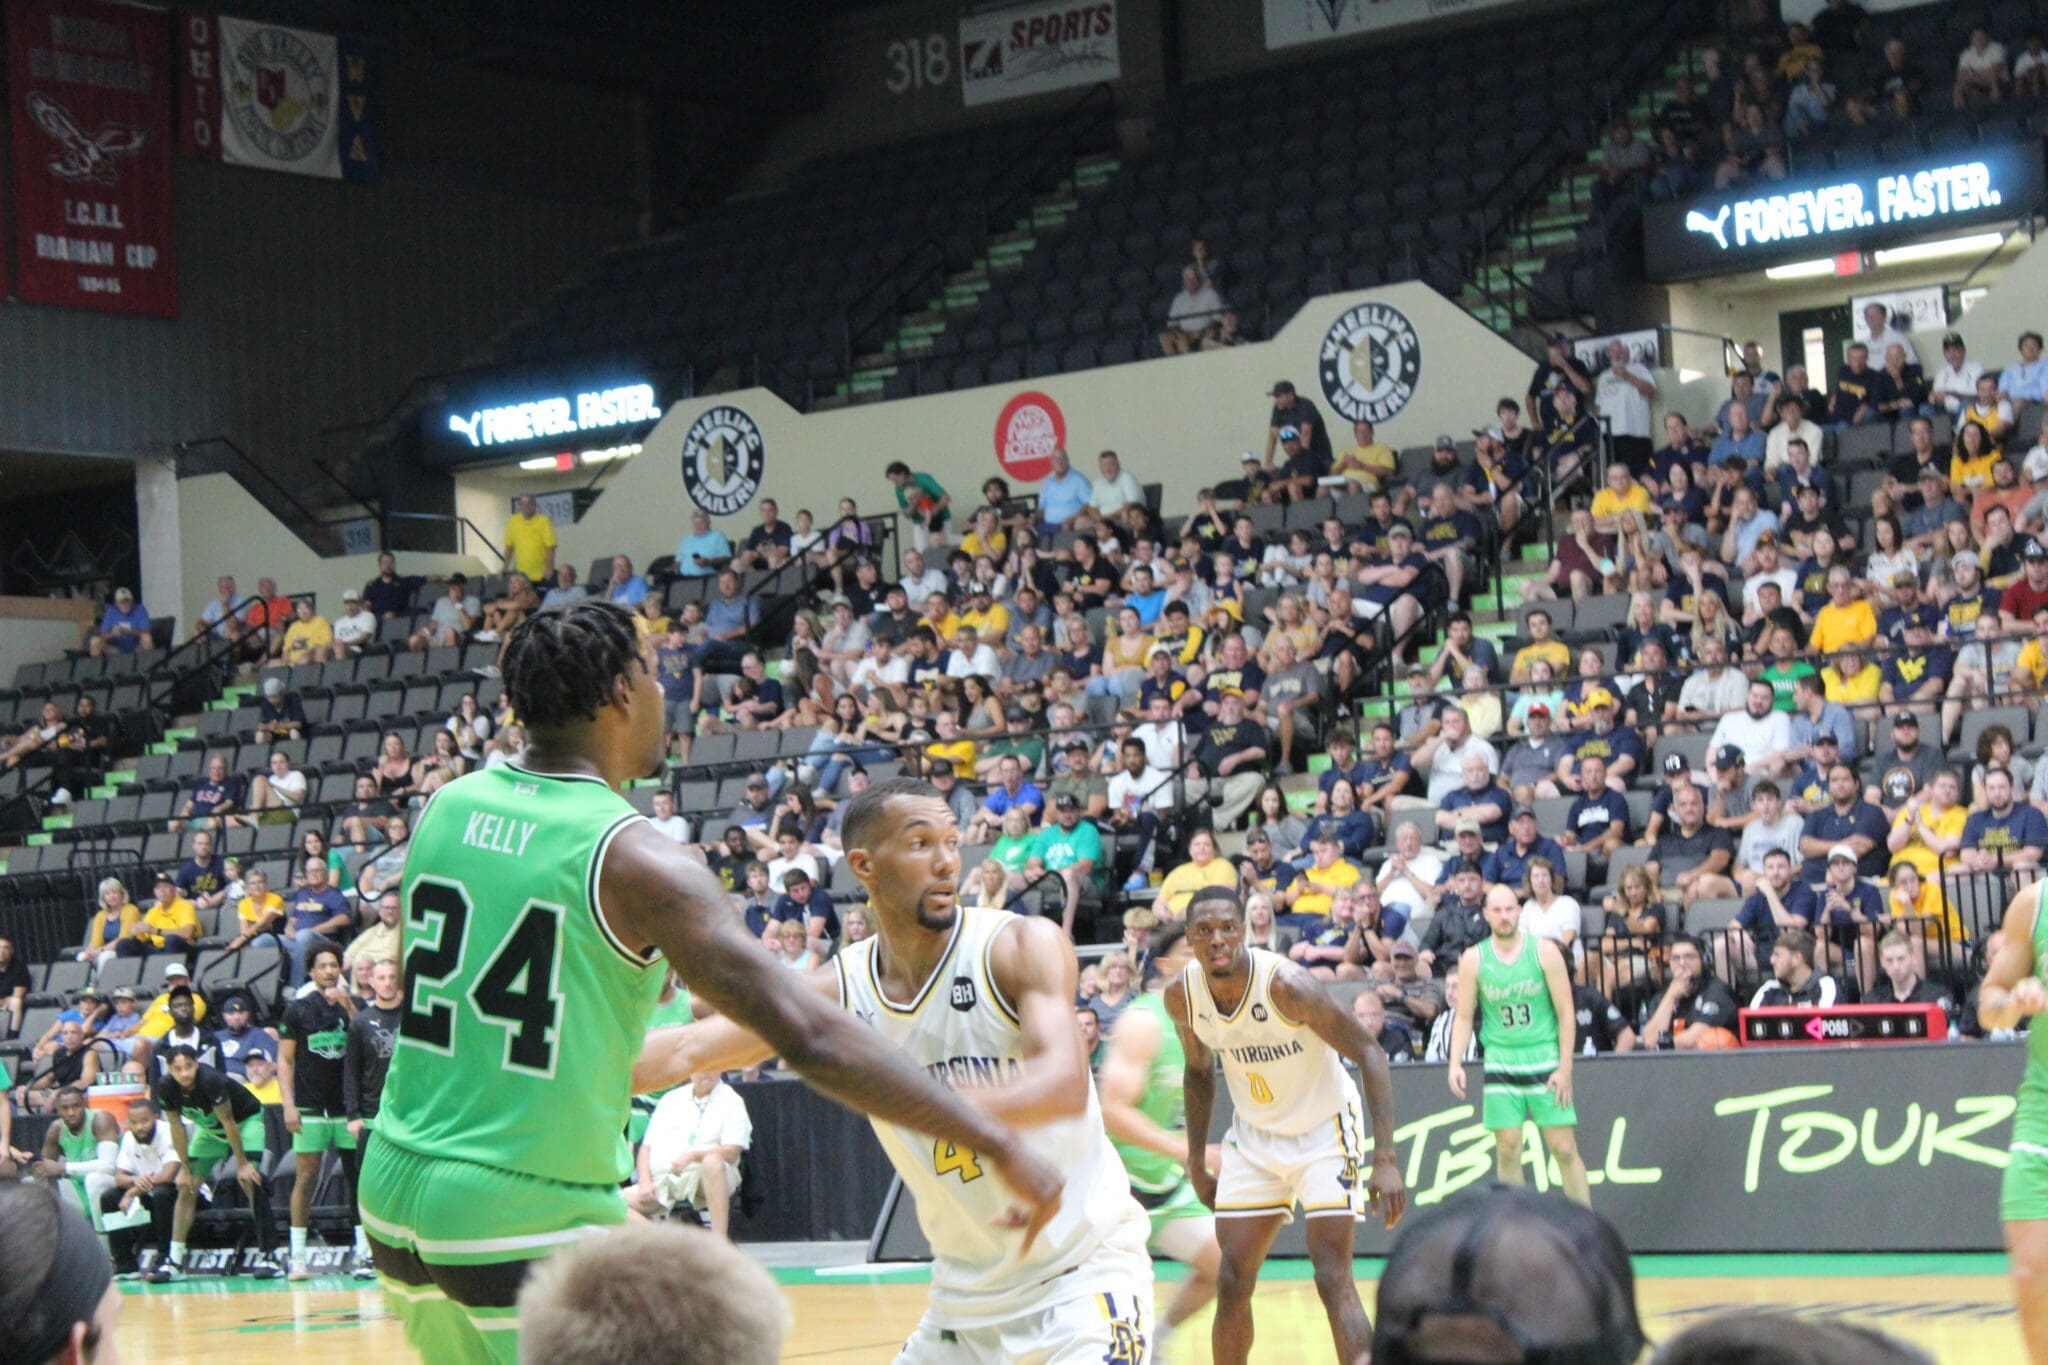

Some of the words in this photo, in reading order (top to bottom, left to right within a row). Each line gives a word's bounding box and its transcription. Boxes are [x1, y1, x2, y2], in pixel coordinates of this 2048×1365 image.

[1011, 4, 1112, 51] SPORTS
[189, 17, 212, 147] OHIO
[886, 33, 950, 94] 318
[1733, 182, 1875, 246] FOREVER.
[1878, 161, 2001, 222] FASTER.
[1322, 305, 1415, 360] WHEELING
[1331, 381, 1411, 423] NAILERS
[684, 409, 760, 457] WHEELING
[691, 477, 757, 514] NAILERS
[463, 810, 538, 856] KELLY
[399, 873, 566, 1080] 24
[952, 983, 974, 1004] BH
[1501, 1003, 1533, 1029] 33
[924, 1056, 1021, 1091] IRGINIA
[1230, 1040, 1304, 1064] VIRGINIA
[1246, 1072, 1274, 1104] 0
[934, 1138, 983, 1183] 4
